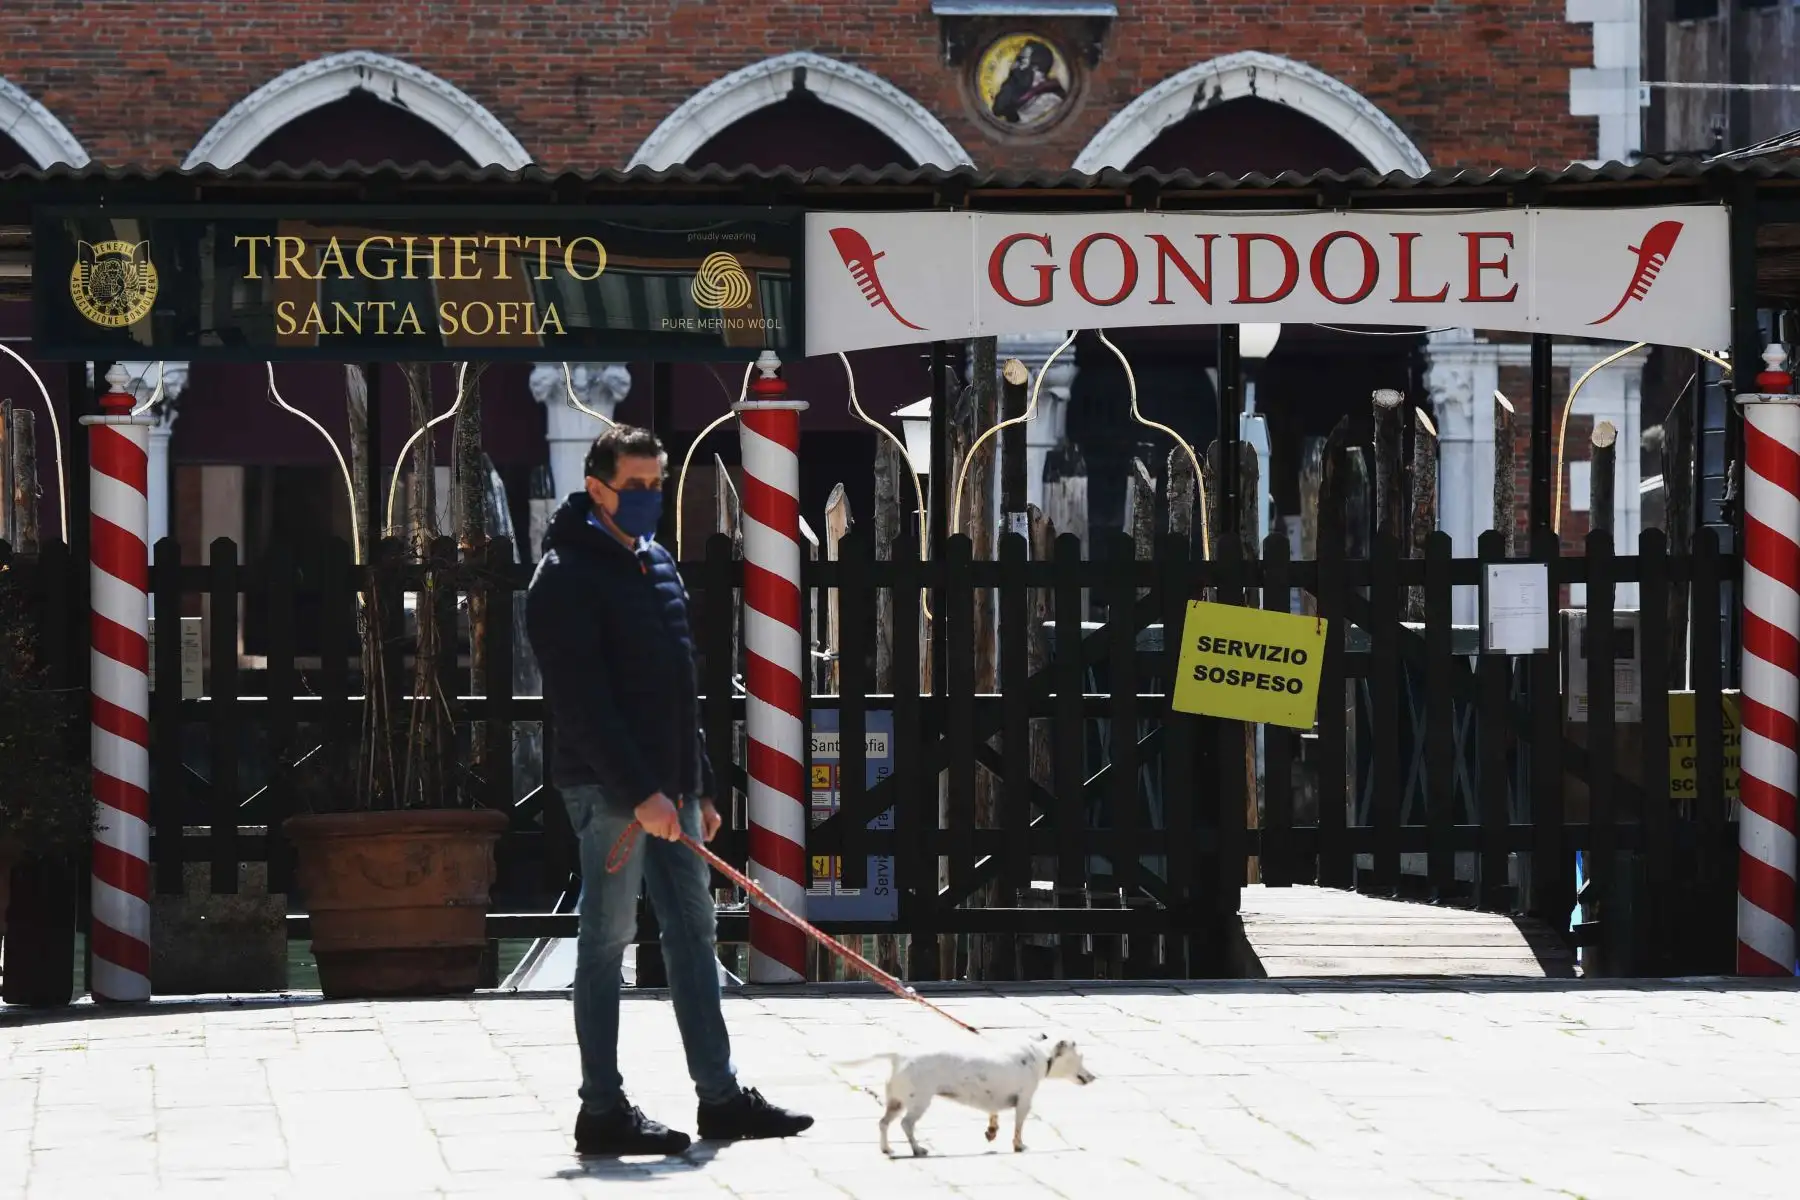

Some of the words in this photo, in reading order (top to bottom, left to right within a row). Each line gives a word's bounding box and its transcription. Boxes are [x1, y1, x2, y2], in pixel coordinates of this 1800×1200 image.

[93, 242, 135, 255] VENEZIA
[687, 232, 719, 243] proudly
[721, 234, 756, 243] wearing
[234, 235, 608, 281] TRAGHETTO
[988, 230, 1519, 307] GONDOLE
[72, 276, 120, 325] ASSOCIAZIONE
[124, 274, 157, 323] GONDOLIERI
[276, 300, 426, 335] SANTA
[439, 300, 568, 335] SOFIA
[662, 318, 694, 329] PURE
[697, 318, 744, 329] MERINO
[747, 318, 782, 329] WOOL
[1197, 635, 1308, 666] SERVIZIO
[1193, 664, 1303, 695] SOSPESO
[811, 738, 841, 753] Sant
